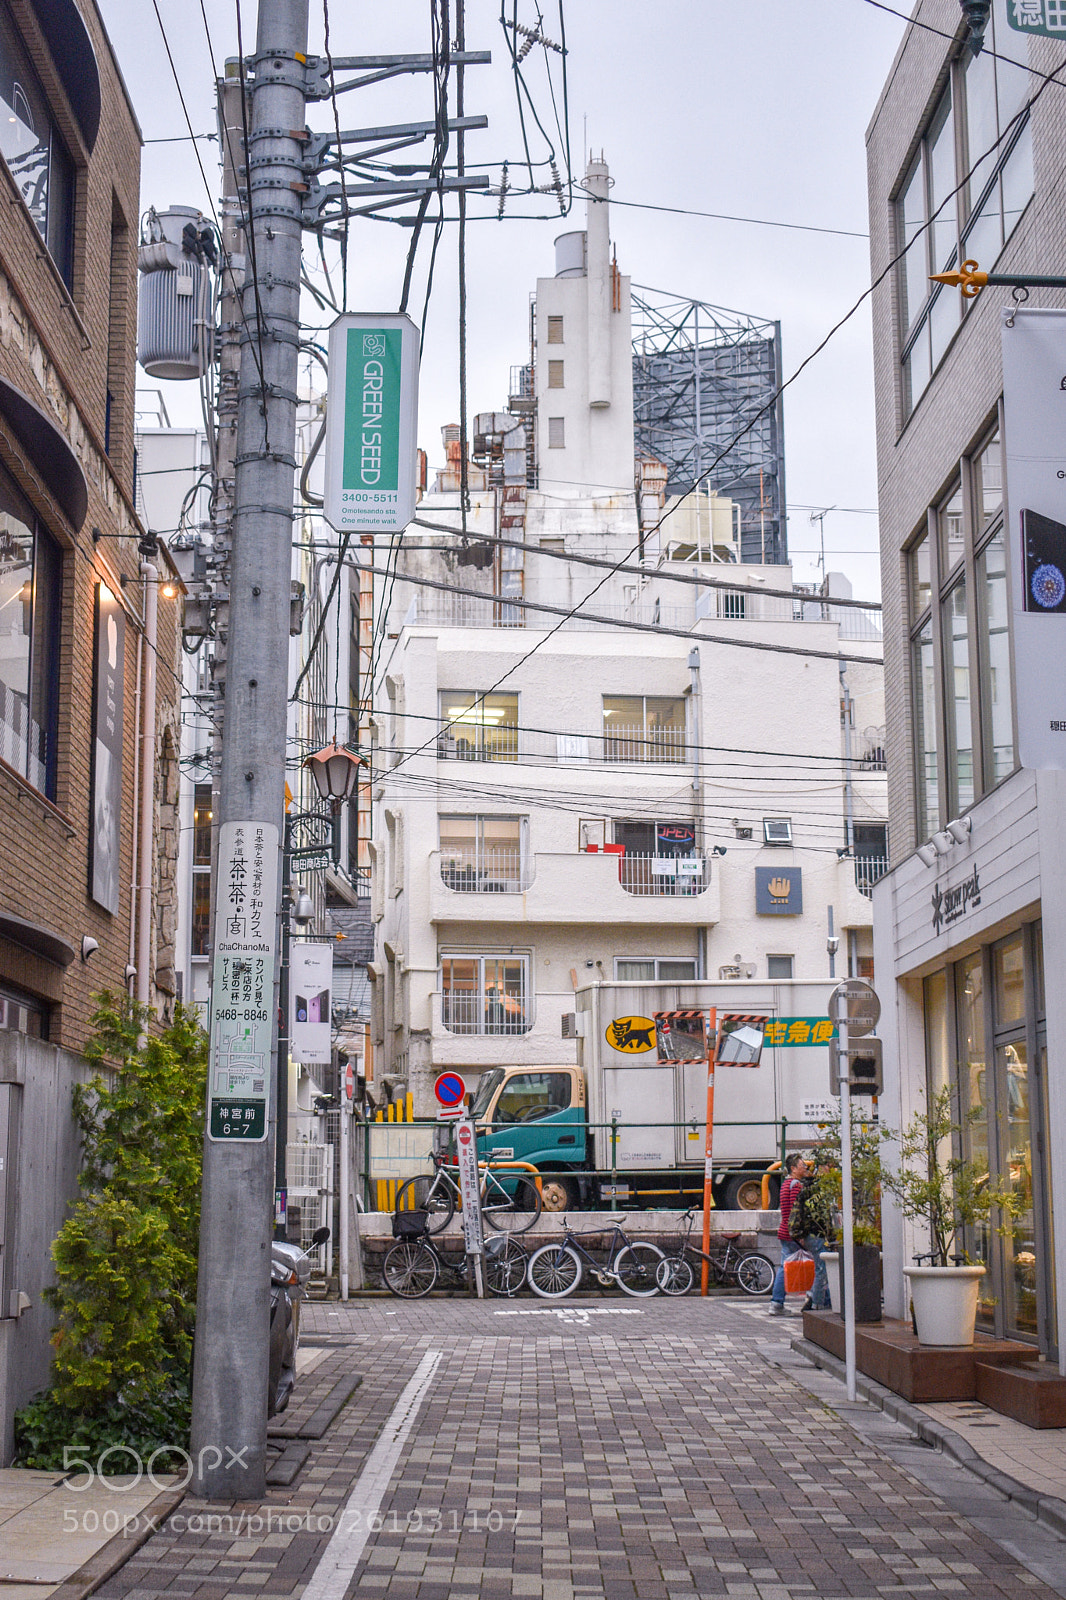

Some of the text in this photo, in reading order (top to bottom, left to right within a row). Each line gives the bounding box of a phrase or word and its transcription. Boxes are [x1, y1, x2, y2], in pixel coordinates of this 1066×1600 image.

[361, 361, 384, 485] GREEN SEED
[342, 493, 398, 502] 3400-5511
[341, 507, 383, 515] Omotesando
[657, 826, 695, 839] OPEN
[218, 942, 270, 952] ChaChanoMa
[221, 957, 230, 992] サービス
[242, 957, 253, 1002] ご来店の方
[254, 957, 264, 1009] カンバン見て
[215, 1008, 268, 1021] 5468-8846
[764, 1020, 834, 1044] 宅急便
[220, 1107, 256, 1120] 神宮前
[223, 1123, 250, 1135] 6-7
